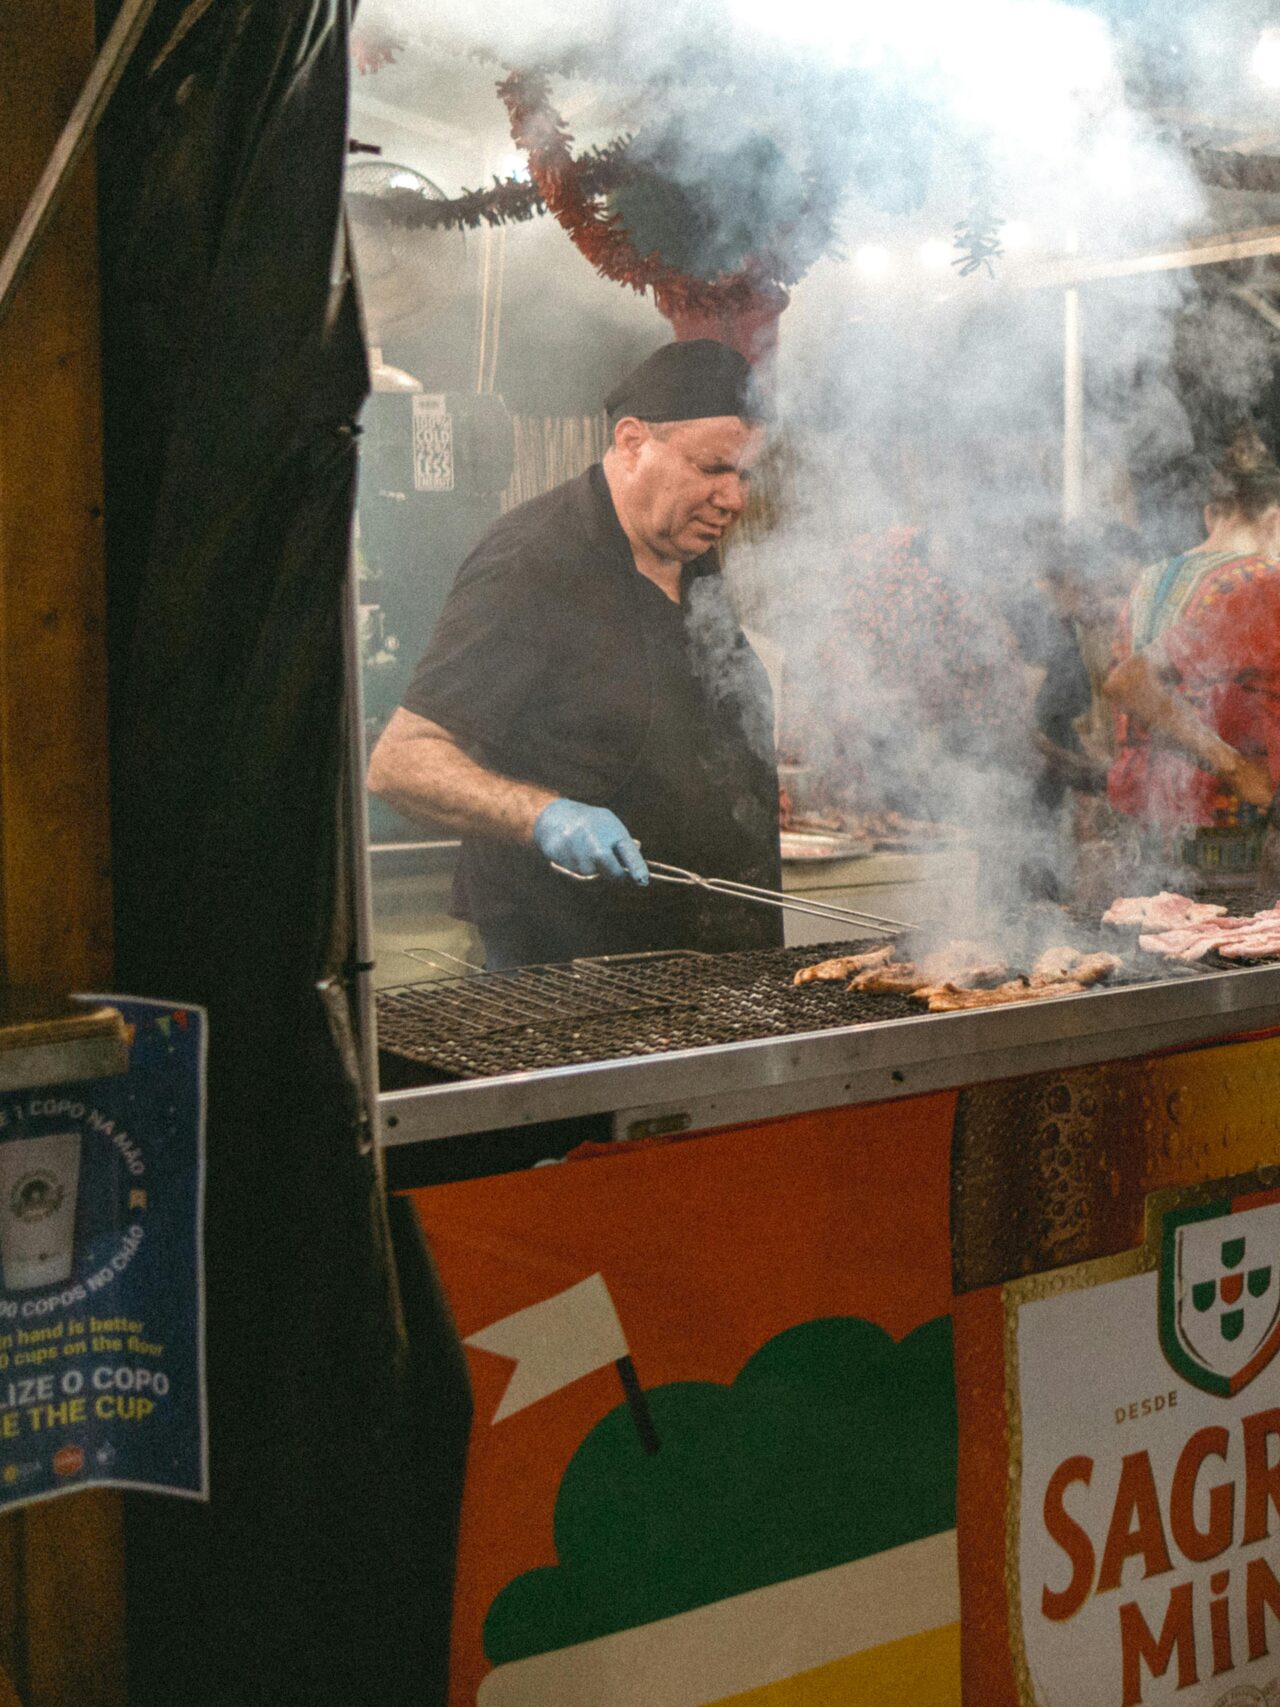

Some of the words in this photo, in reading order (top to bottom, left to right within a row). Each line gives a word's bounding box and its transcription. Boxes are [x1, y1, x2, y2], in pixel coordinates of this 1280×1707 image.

[22, 1285, 87, 1317] COPOS
[17, 1322, 64, 1344] hand
[67, 1319, 85, 1336] is
[89, 1316, 145, 1334] better
[14, 1346, 58, 1367] cups
[63, 1341, 87, 1356] on
[92, 1336, 123, 1352] the
[127, 1335, 164, 1357] floor
[61, 1369, 85, 1394] O
[92, 1366, 170, 1396] COPO
[28, 1398, 87, 1431] THE
[95, 1395, 154, 1422] CUP
[1115, 1390, 1179, 1425] DESDE
